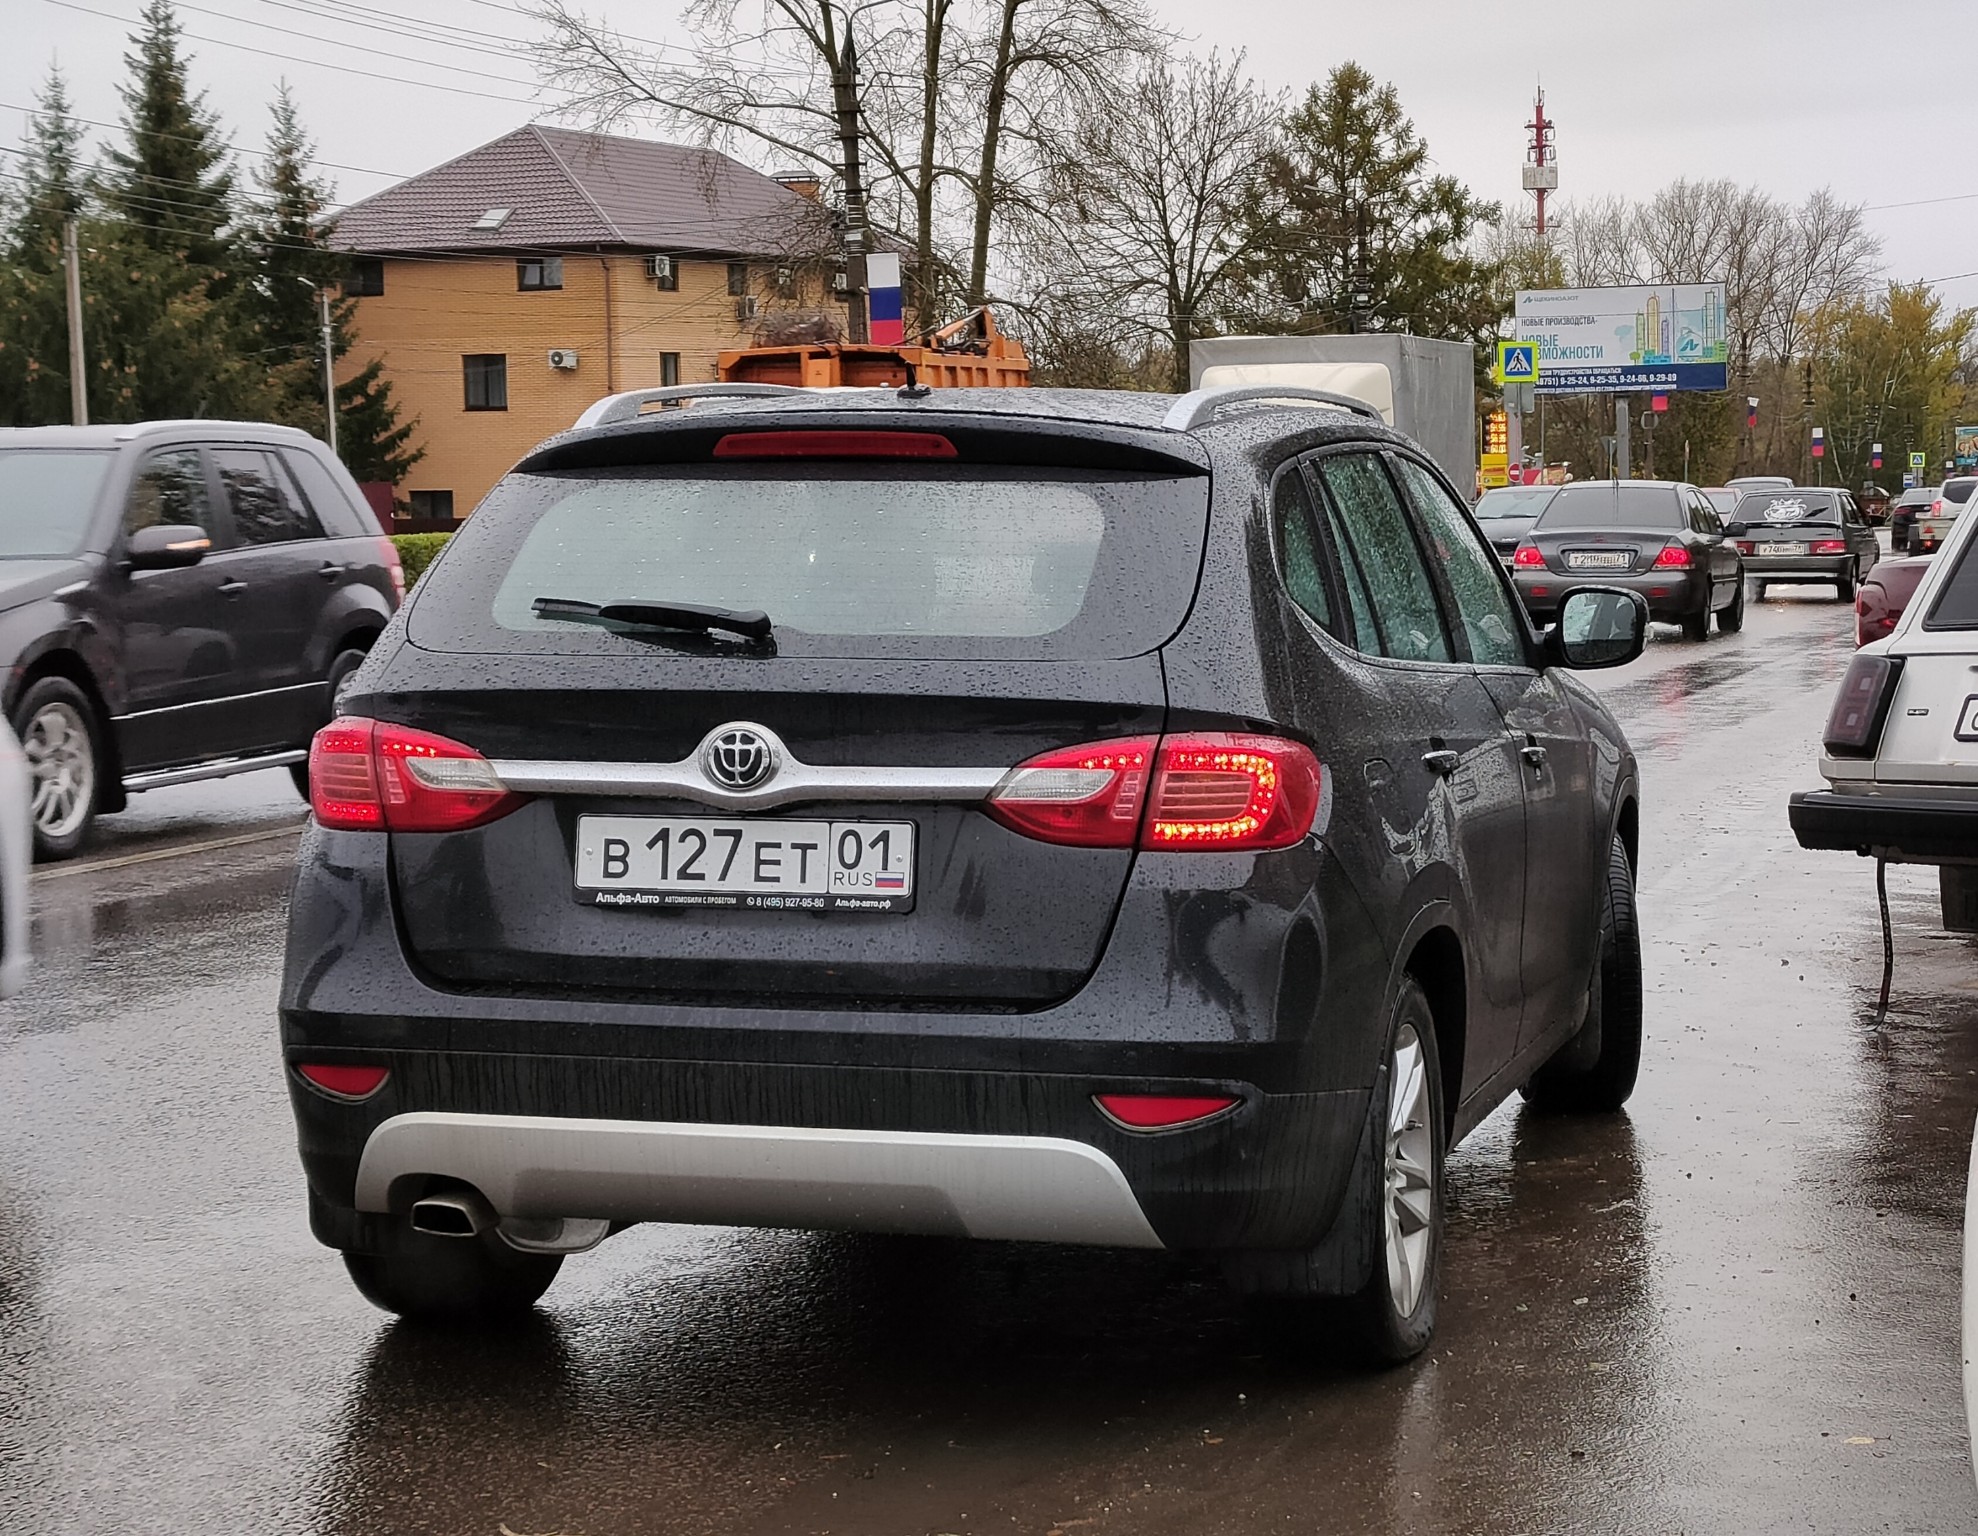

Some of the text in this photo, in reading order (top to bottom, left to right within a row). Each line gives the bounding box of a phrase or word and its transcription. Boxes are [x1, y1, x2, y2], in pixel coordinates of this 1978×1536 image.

[1521, 317, 1544, 327] НОВЫЕ
[1521, 334, 1559, 347] НОВЫЕ
[1537, 345, 1604, 360] ЗМОЖНОСТИ
[837, 829, 890, 871] 01
[833, 871, 873, 887] RUS
[596, 892, 891, 909] Альфа-Авто АВТОМОБИЛИ С ПРОБЕГОМ 8 (495) 927-95-80 Альфа-авто.рф
